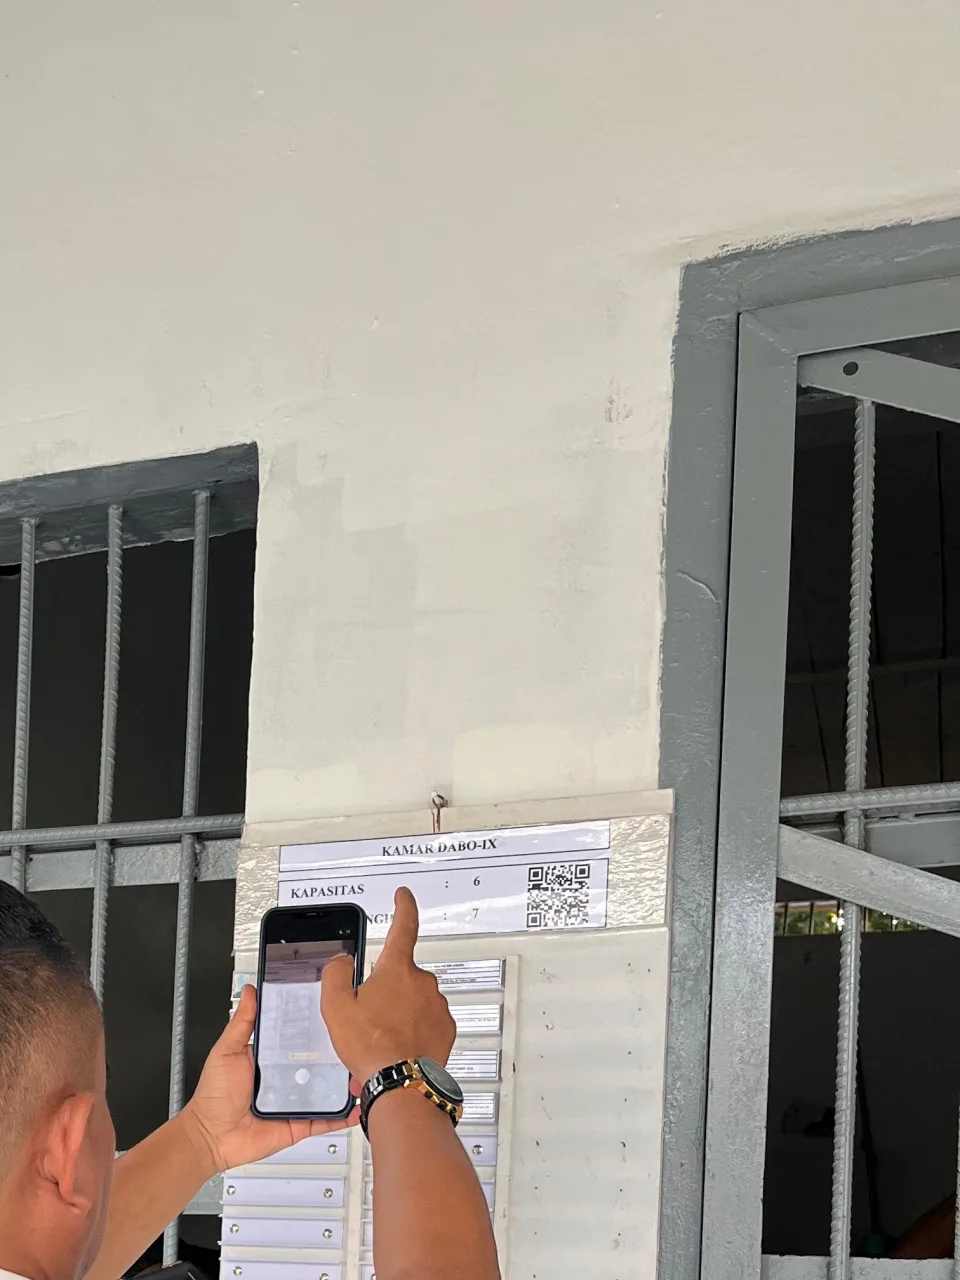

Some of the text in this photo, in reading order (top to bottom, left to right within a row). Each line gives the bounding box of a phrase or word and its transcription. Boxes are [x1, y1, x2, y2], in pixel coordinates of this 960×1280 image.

[382, 839, 498, 857] KAMAR DABO-IX
[291, 884, 365, 899] KAPASITAS
[473, 876, 481, 887] 6
[472, 908, 480, 919] 7
